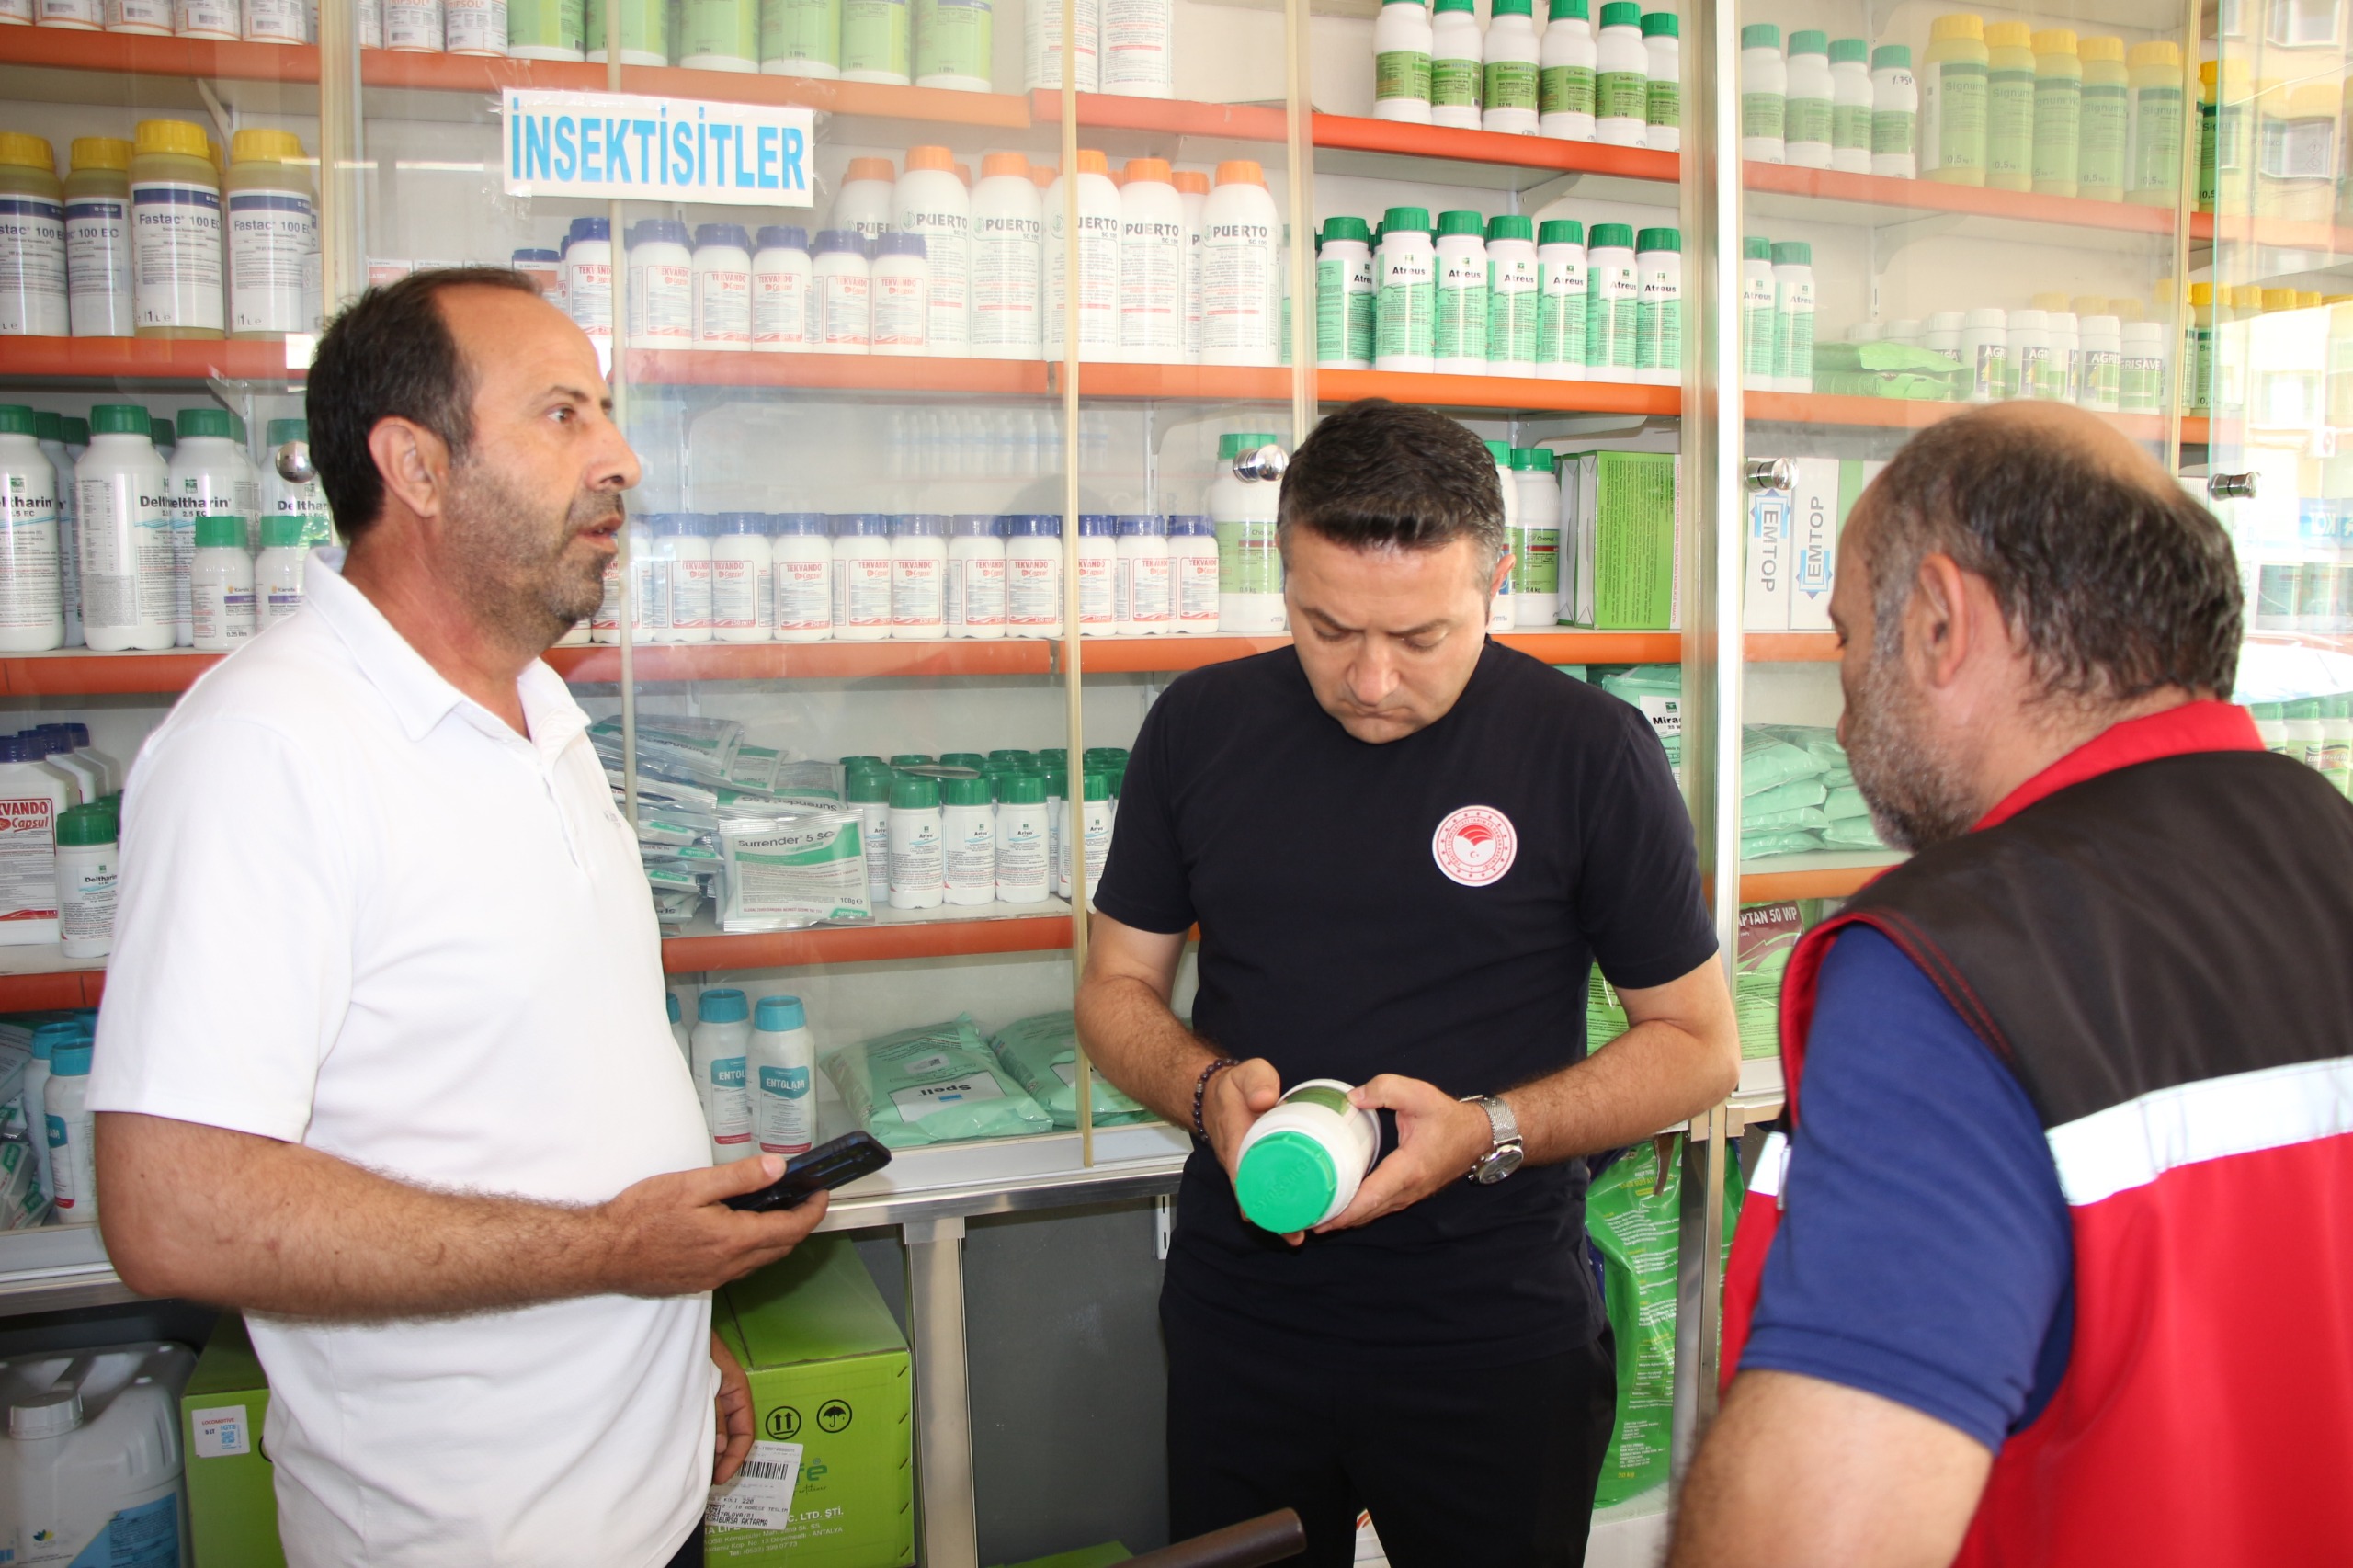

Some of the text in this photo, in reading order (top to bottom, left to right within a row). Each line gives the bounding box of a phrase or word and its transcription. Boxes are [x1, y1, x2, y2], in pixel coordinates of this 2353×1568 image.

[2036, 97, 2065, 108] gnum
[512, 97, 806, 190] İNSEKTİSİTLER
[139, 214, 183, 225] Fastac
[189, 216, 210, 227] 100
[234, 220, 273, 231] Fastac
[281, 222, 301, 232] 100
[916, 214, 968, 228] PUERTO
[985, 219, 1040, 233] PUERTO
[36, 227, 54, 238] 100
[79, 228, 119, 238] 100 EC
[1126, 223, 1179, 236] PUERTO
[1213, 226, 1267, 238] PUERTO
[1392, 267, 1426, 276] Atreus
[1449, 269, 1482, 278] Atreus
[1354, 274, 1372, 284] Atreu
[1505, 274, 1535, 284] Atreus
[1553, 276, 1584, 286] Atreus
[1610, 280, 1636, 290] Atreus
[1644, 284, 1677, 293] Atreus
[172, 497, 230, 509] eltharin
[1807, 496, 1824, 578] EMTOP
[1761, 509, 1779, 593] EMTOP
[787, 563, 822, 573] TEKVANDO
[899, 561, 933, 570] TEKVANDO
[1015, 561, 1049, 569] TEKVANDO
[12, 816, 49, 832] Capsul
[1017, 828, 1033, 836] Arivo
[738, 836, 799, 847] Surrender
[817, 831, 835, 840] SG
[1769, 908, 1782, 923] 50
[1782, 906, 1798, 922] WP
[719, 1070, 746, 1082] ENTOL
[767, 1078, 805, 1090] ENTOLAM
[920, 1084, 972, 1096] Spell
[801, 1506, 844, 1521] LTD. ŞTİ.
[742, 1518, 768, 1527] AKTARMA
[812, 1527, 844, 1537] ANTALYA
